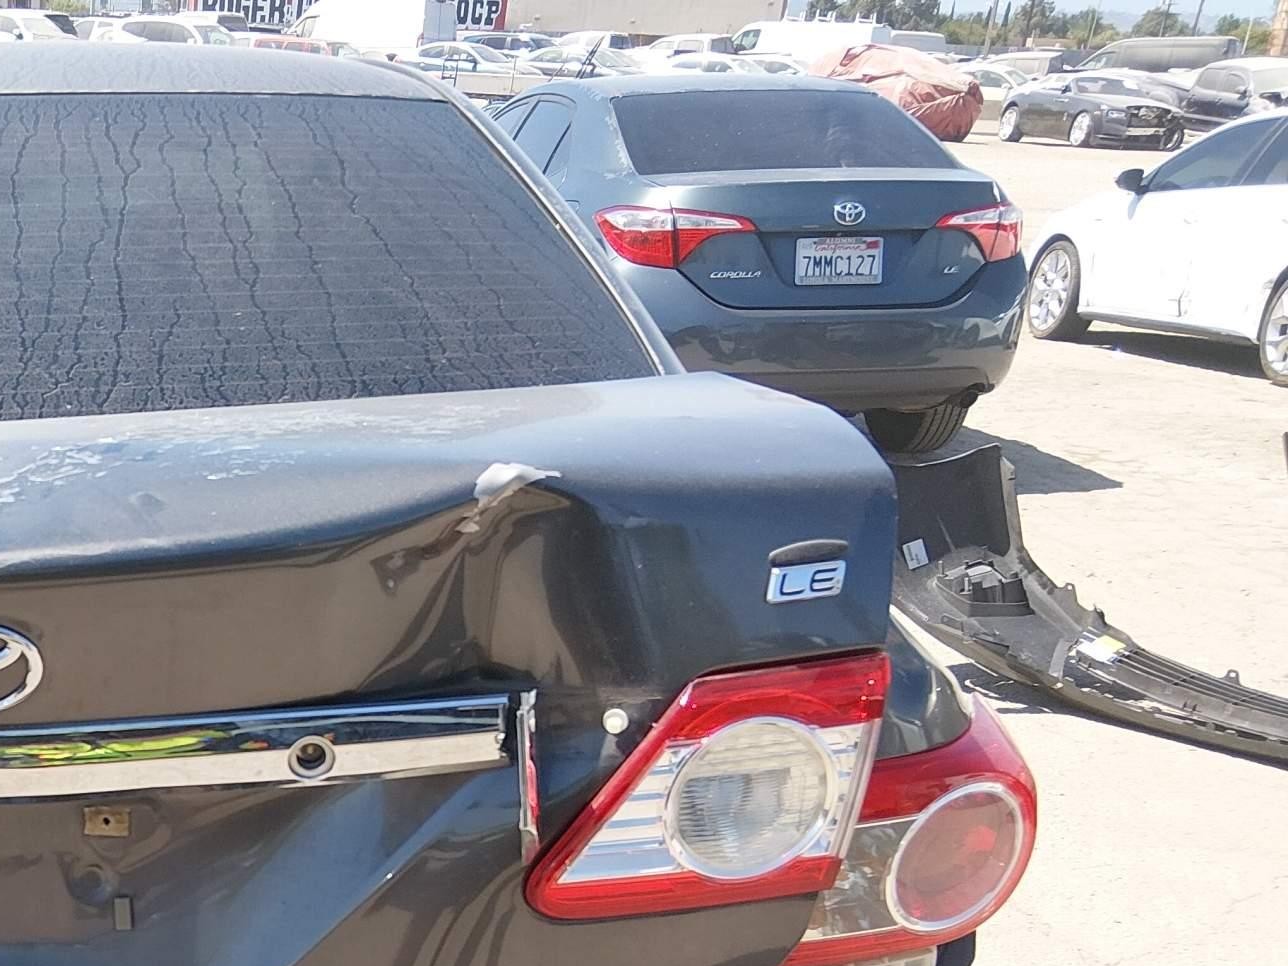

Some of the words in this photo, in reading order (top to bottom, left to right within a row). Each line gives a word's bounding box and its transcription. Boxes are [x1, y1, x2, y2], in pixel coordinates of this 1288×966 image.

[802, 254, 876, 277] 7MMC127
[943, 265, 960, 274] LE
[710, 270, 762, 279] COROLLA
[776, 565, 842, 598] LE
